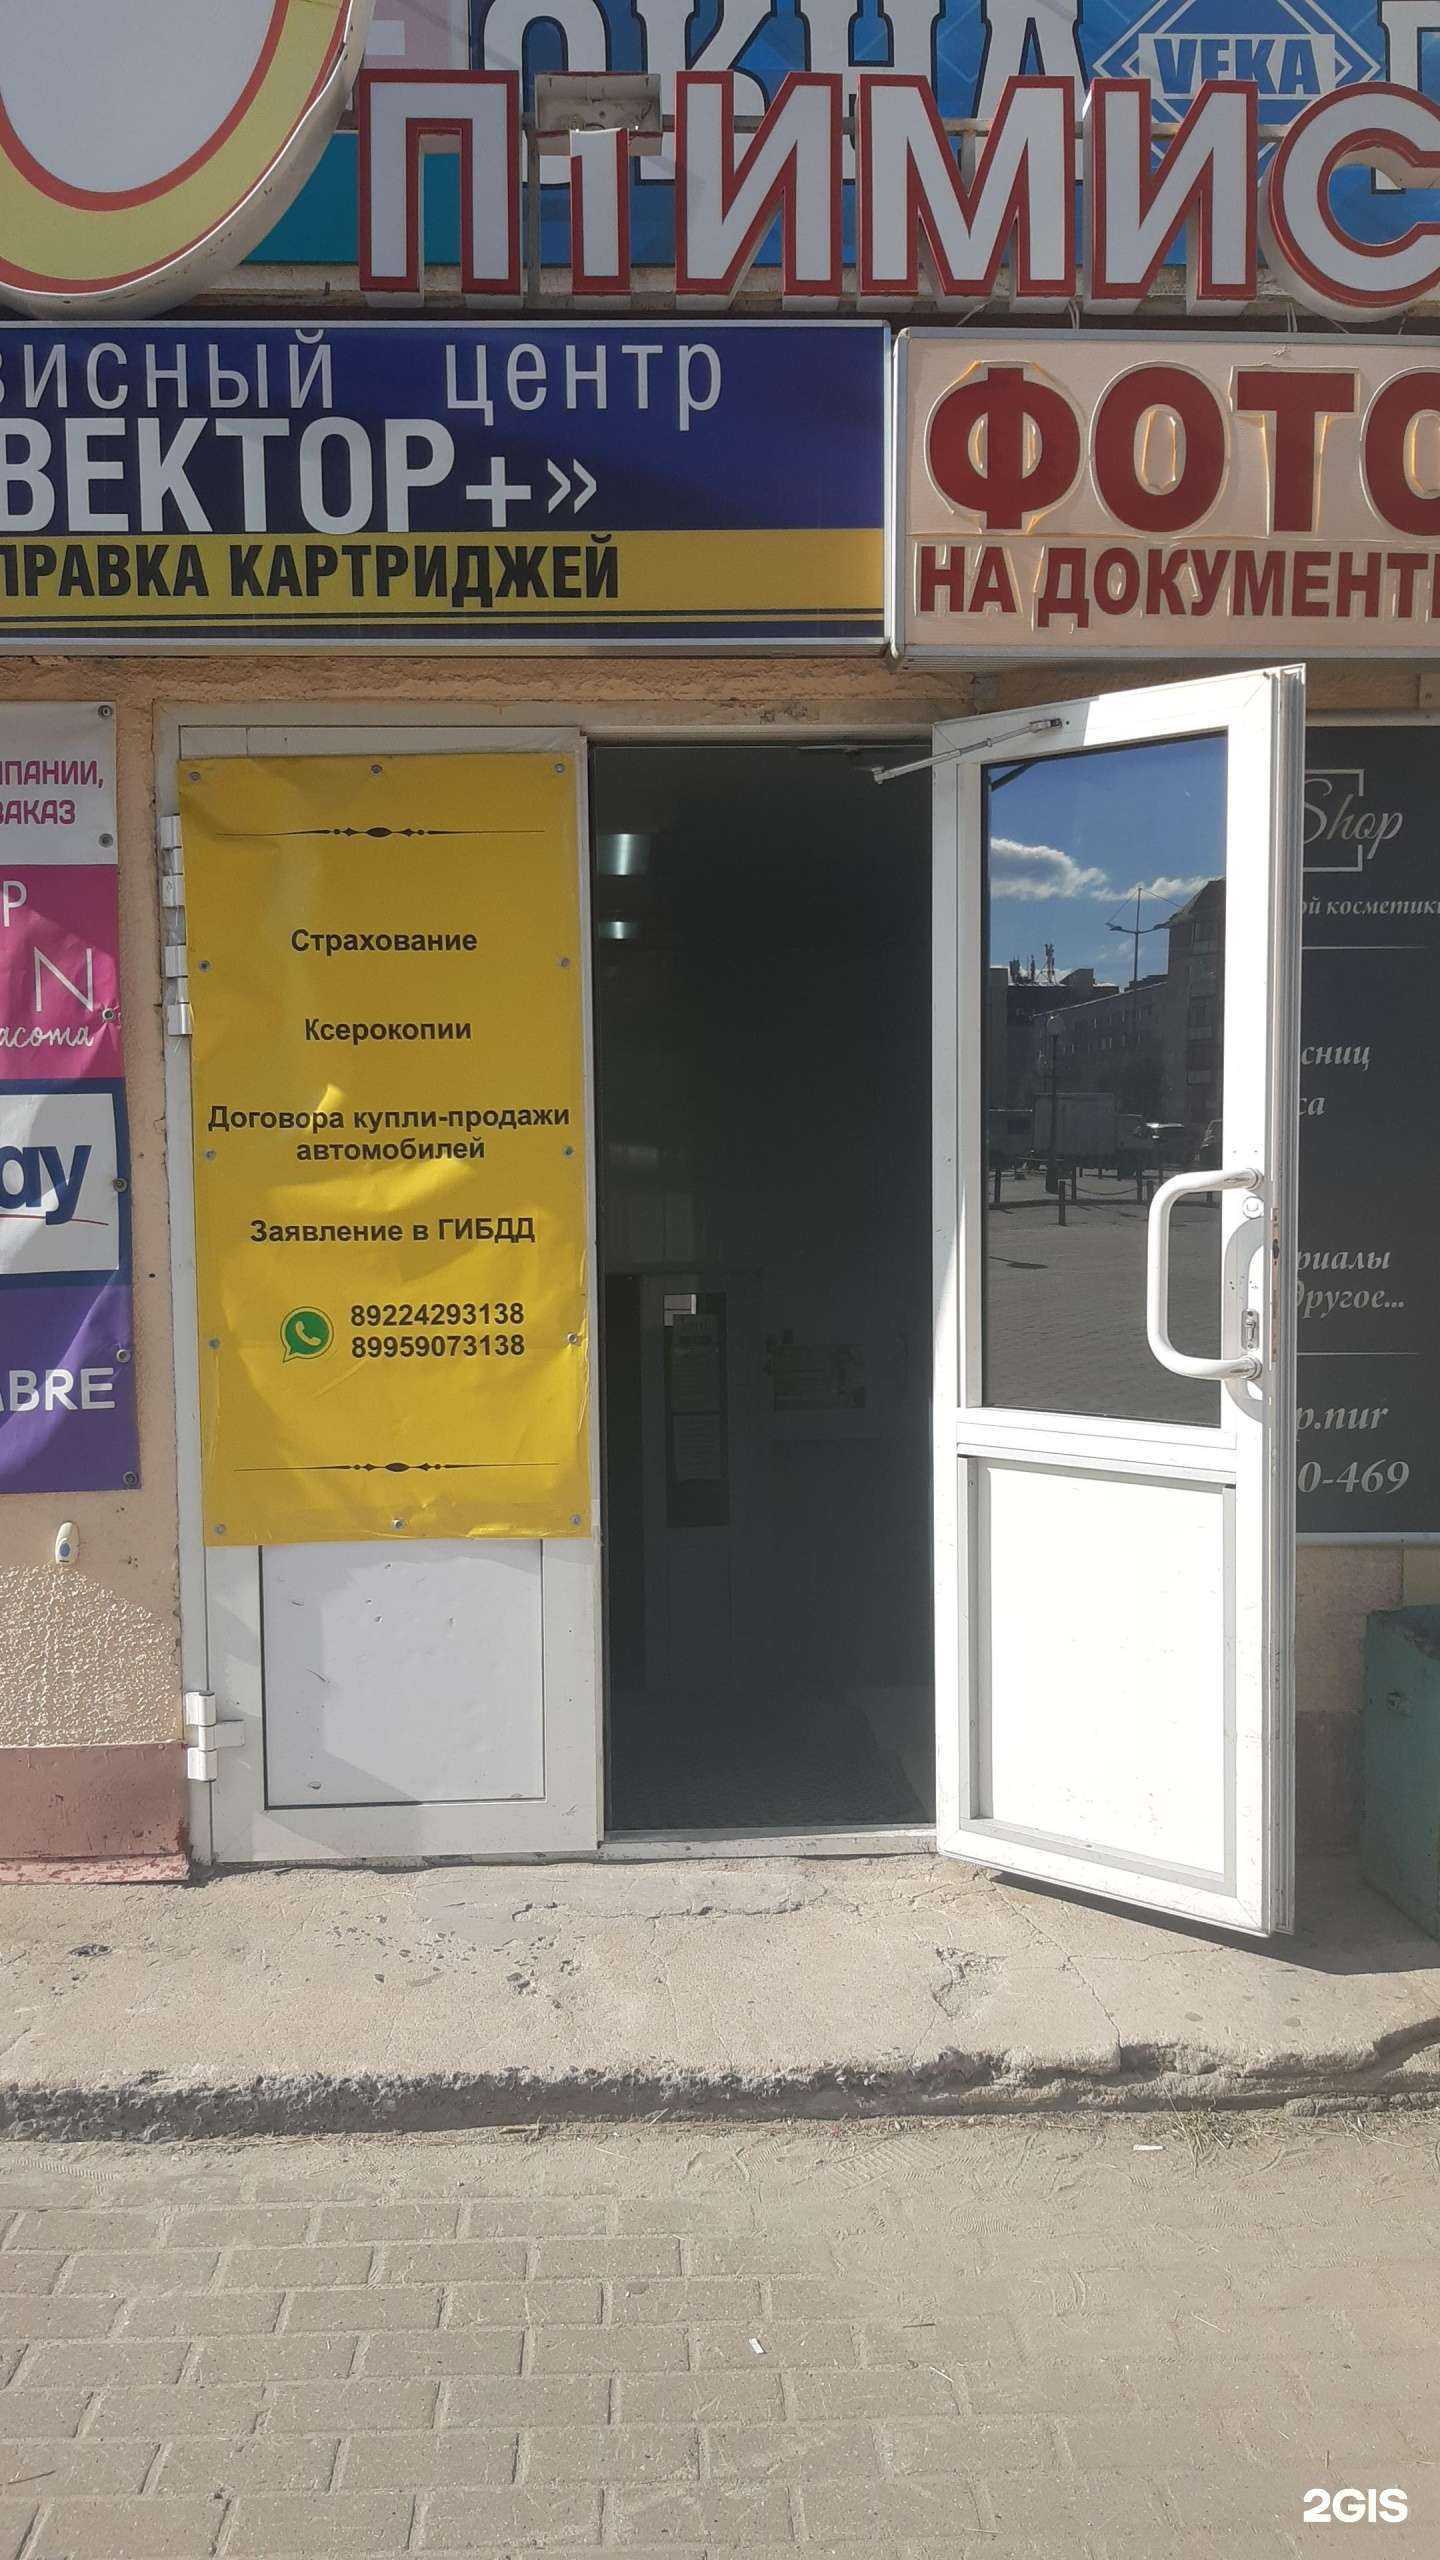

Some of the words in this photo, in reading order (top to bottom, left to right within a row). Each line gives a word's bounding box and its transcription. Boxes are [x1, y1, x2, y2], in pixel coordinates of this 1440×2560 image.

[1154, 39, 1320, 94] VEKA
[0, 328, 334, 410] исный
[446, 341, 722, 431] центр
[929, 367, 1440, 537] ФОТО
[229, 533, 619, 608] КАРТРИДЖЕЙ
[920, 546, 1017, 613] НА
[1037, 547, 1440, 629] ДОКУМЕНТ
[0, 760, 103, 789] ПАНИИ,
[0, 800, 76, 825] АКАЗ
[291, 929, 478, 956] Страхование
[305, 1018, 472, 1045] Ксерокопии
[208, 1105, 344, 1133] Договора
[353, 1107, 570, 1133] купли-продажи
[296, 1136, 485, 1161] автомобилей
[250, 1219, 403, 1243] Заявление
[412, 1223, 429, 1241] в
[438, 1217, 536, 1243] ГИБДД
[350, 1303, 525, 1327] 89224293138
[351, 1334, 525, 1359] 89959073138
[0, 1367, 116, 1412] BRE
